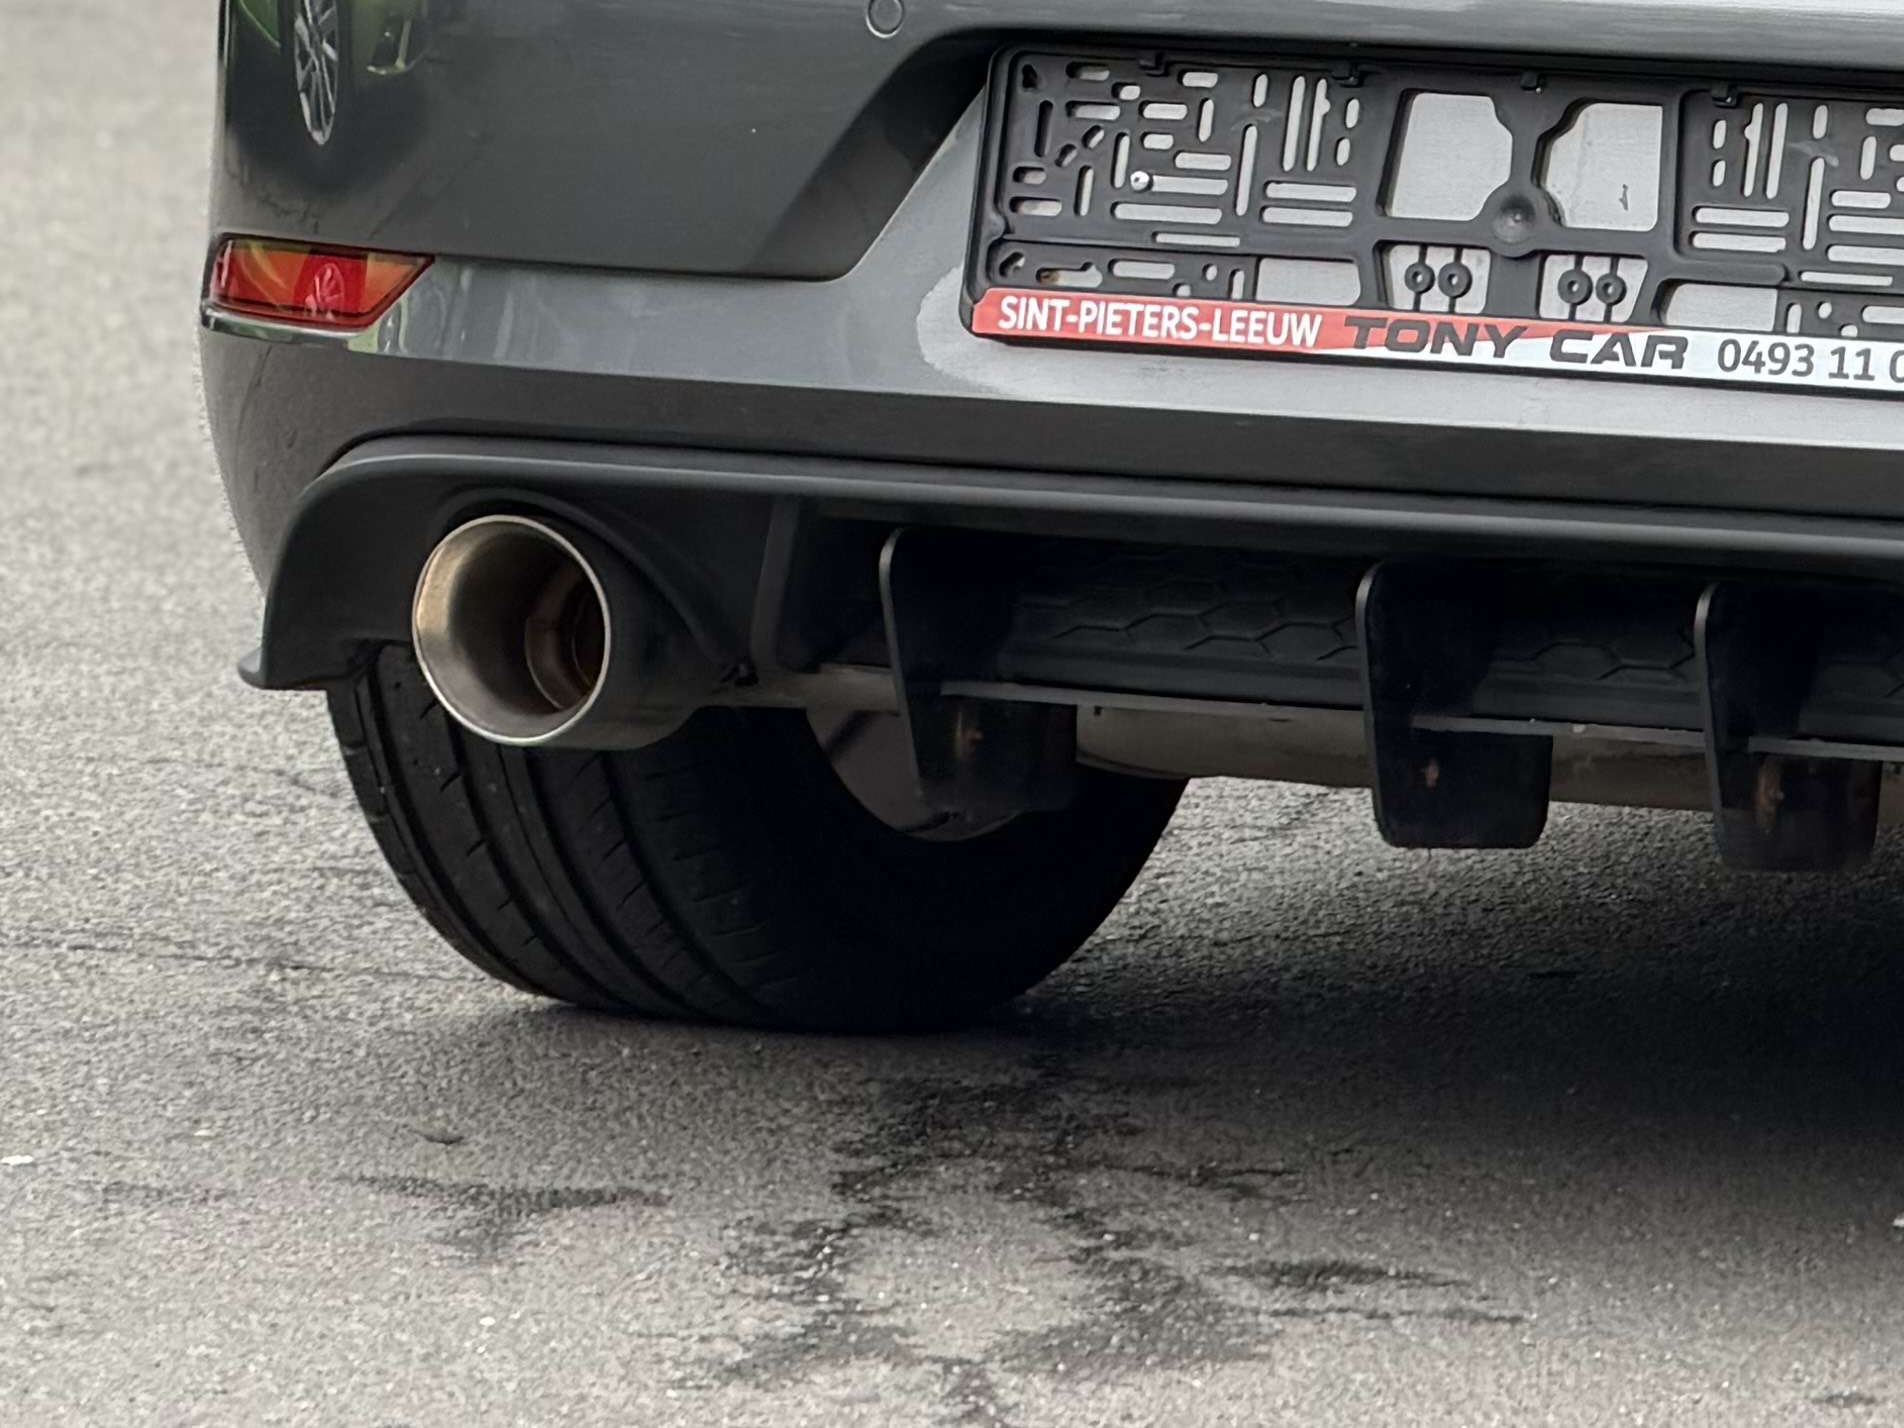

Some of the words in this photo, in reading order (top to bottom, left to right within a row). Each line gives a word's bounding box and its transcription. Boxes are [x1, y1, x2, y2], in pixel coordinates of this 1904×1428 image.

[998, 295, 1323, 348] SINT-PIETERS-LEEUW
[1344, 316, 1528, 359] TONY
[1550, 328, 1689, 370] CAR
[1716, 338, 1815, 377] 0493
[1827, 346, 1876, 382] 11
